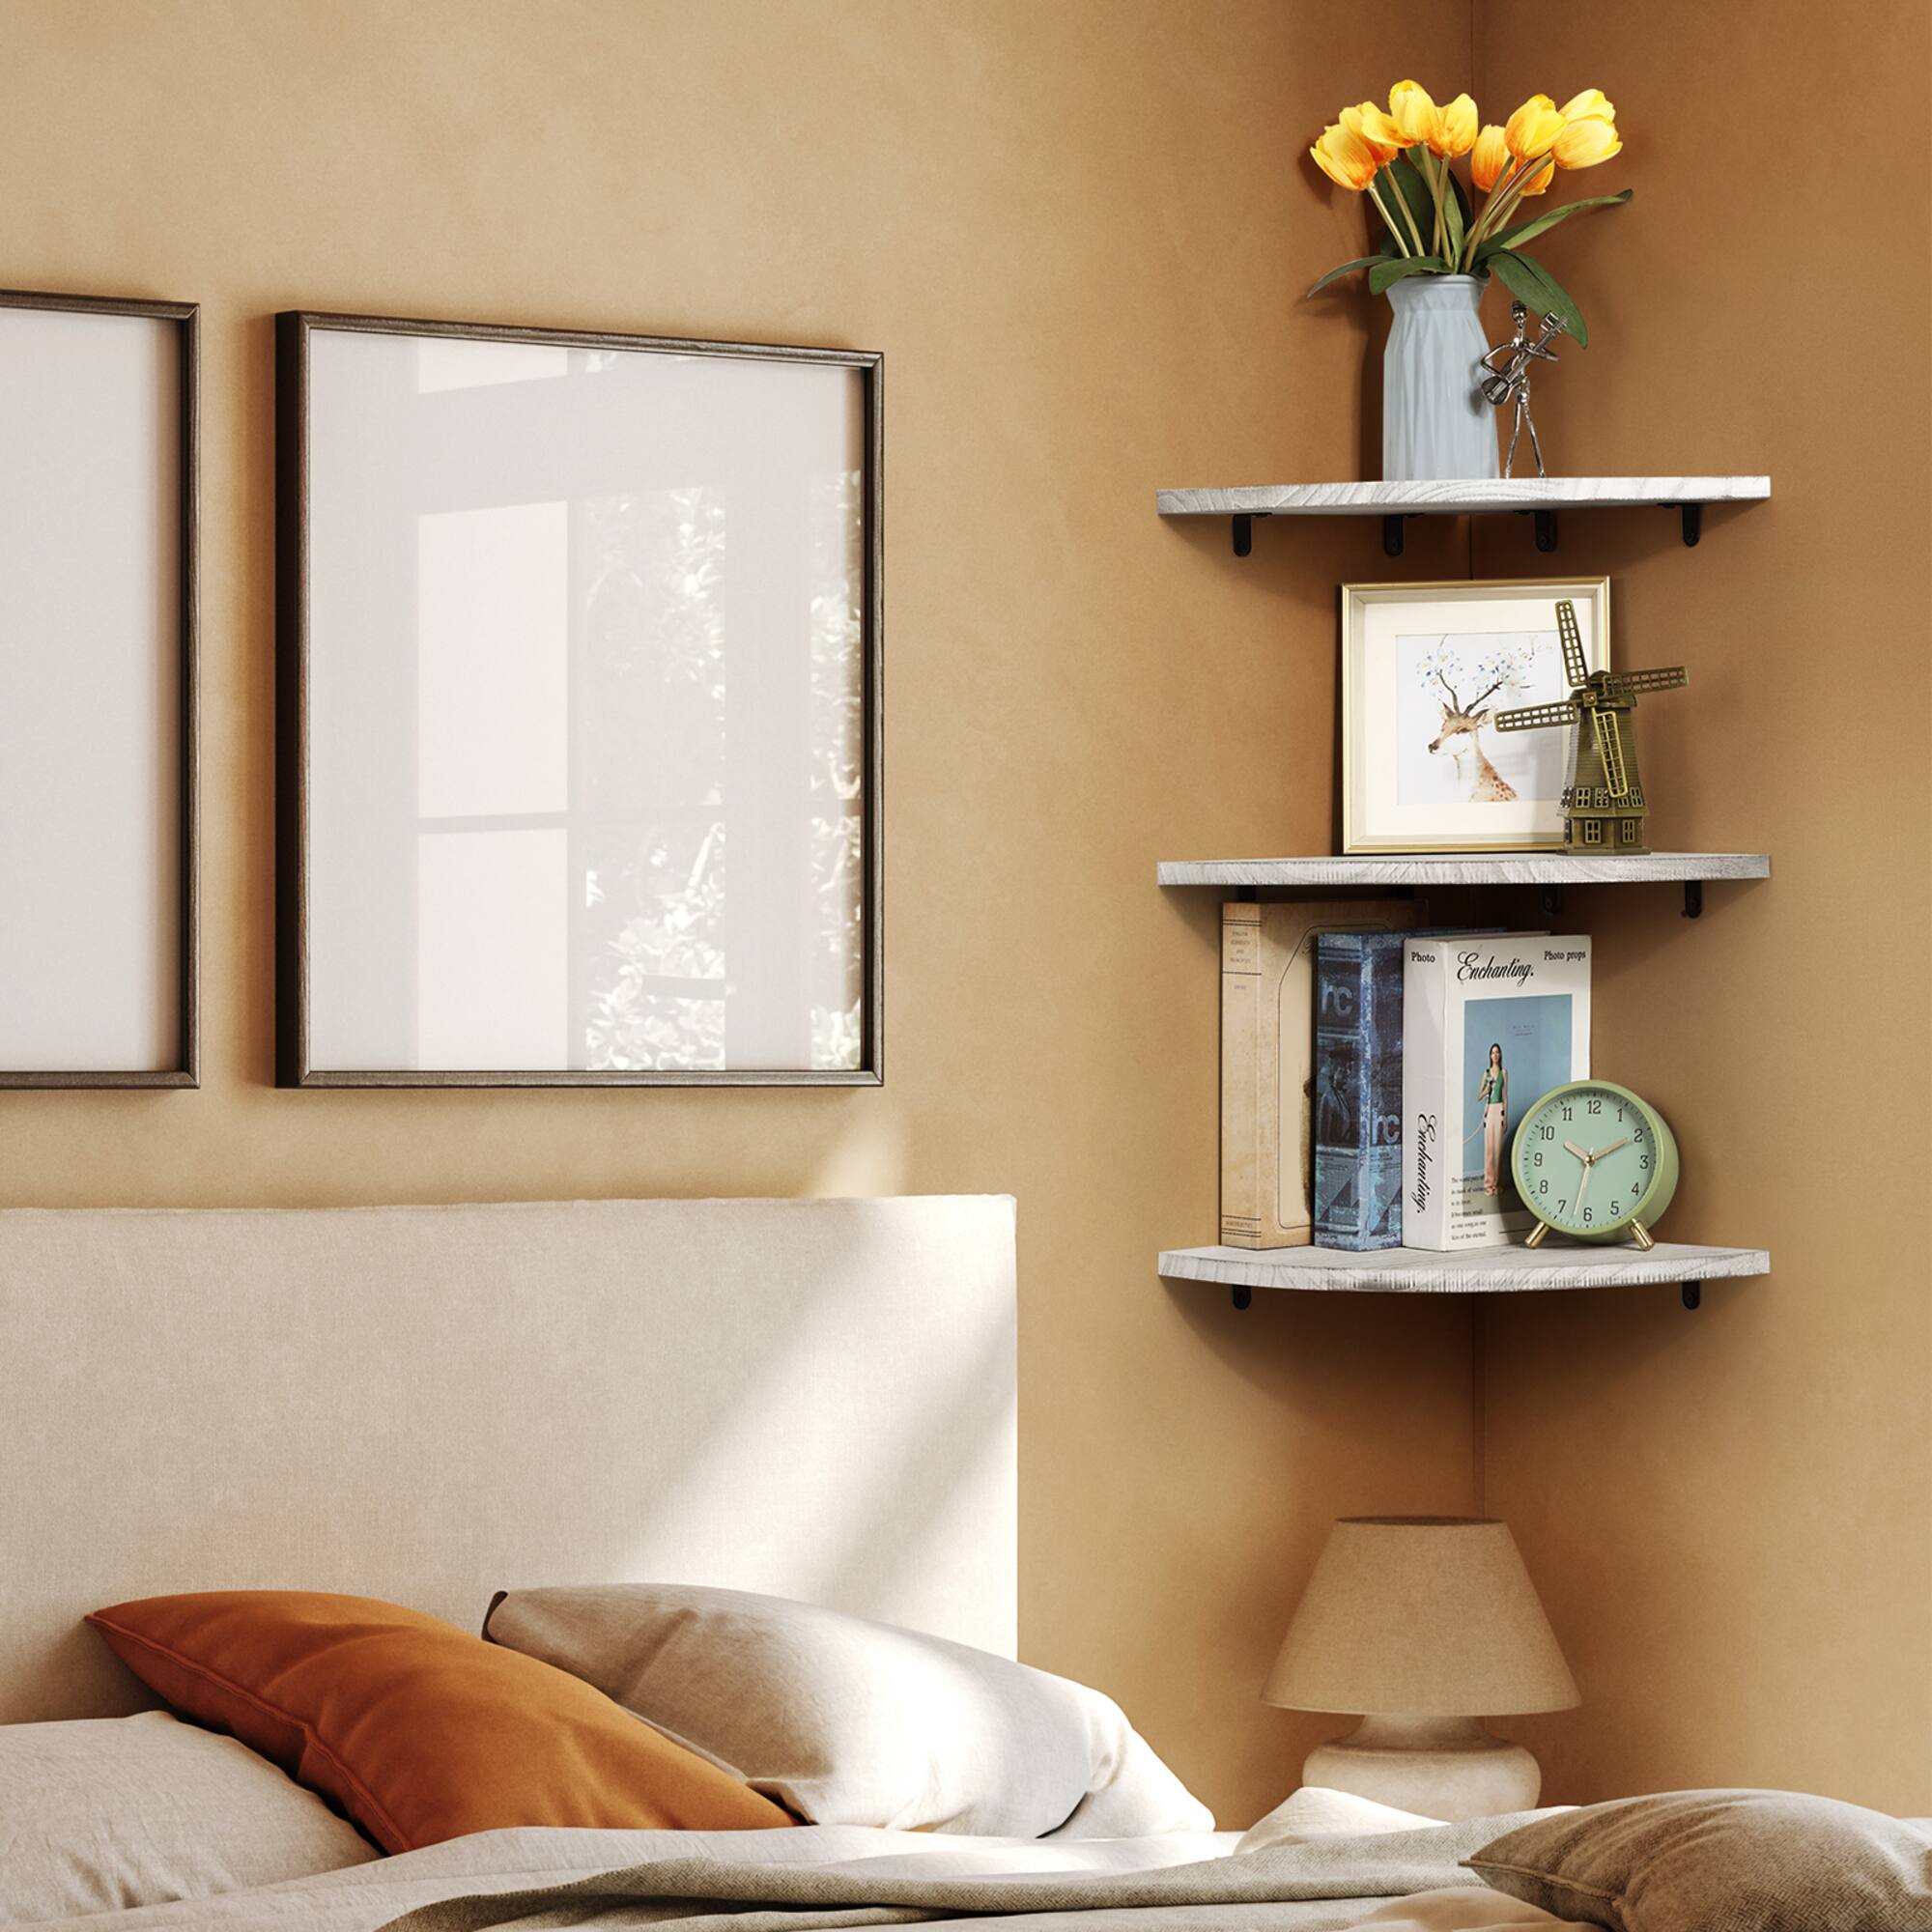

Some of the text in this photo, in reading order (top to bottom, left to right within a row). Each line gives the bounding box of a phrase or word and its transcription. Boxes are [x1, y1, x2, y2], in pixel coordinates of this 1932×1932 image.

[1411, 952, 1435, 963] Photo
[1544, 951, 1586, 961] Photo props
[1457, 952, 1534, 987] Enchanting.
[1587, 1099, 1602, 1114] 12
[1562, 1107, 1572, 1122] 11
[1617, 1108, 1623, 1122] 1
[1540, 1126, 1554, 1140] 10
[1634, 1128, 1642, 1143] 2
[1410, 1114, 1437, 1213] Enchanting.
[1534, 1152, 1543, 1167] 9
[1639, 1155, 1649, 1169] 3
[1540, 1180, 1548, 1194] 8
[1632, 1182, 1639, 1196] 4
[1558, 1200, 1566, 1213] 7
[1610, 1201, 1619, 1215] 5
[1583, 1208, 1592, 1221] 6
